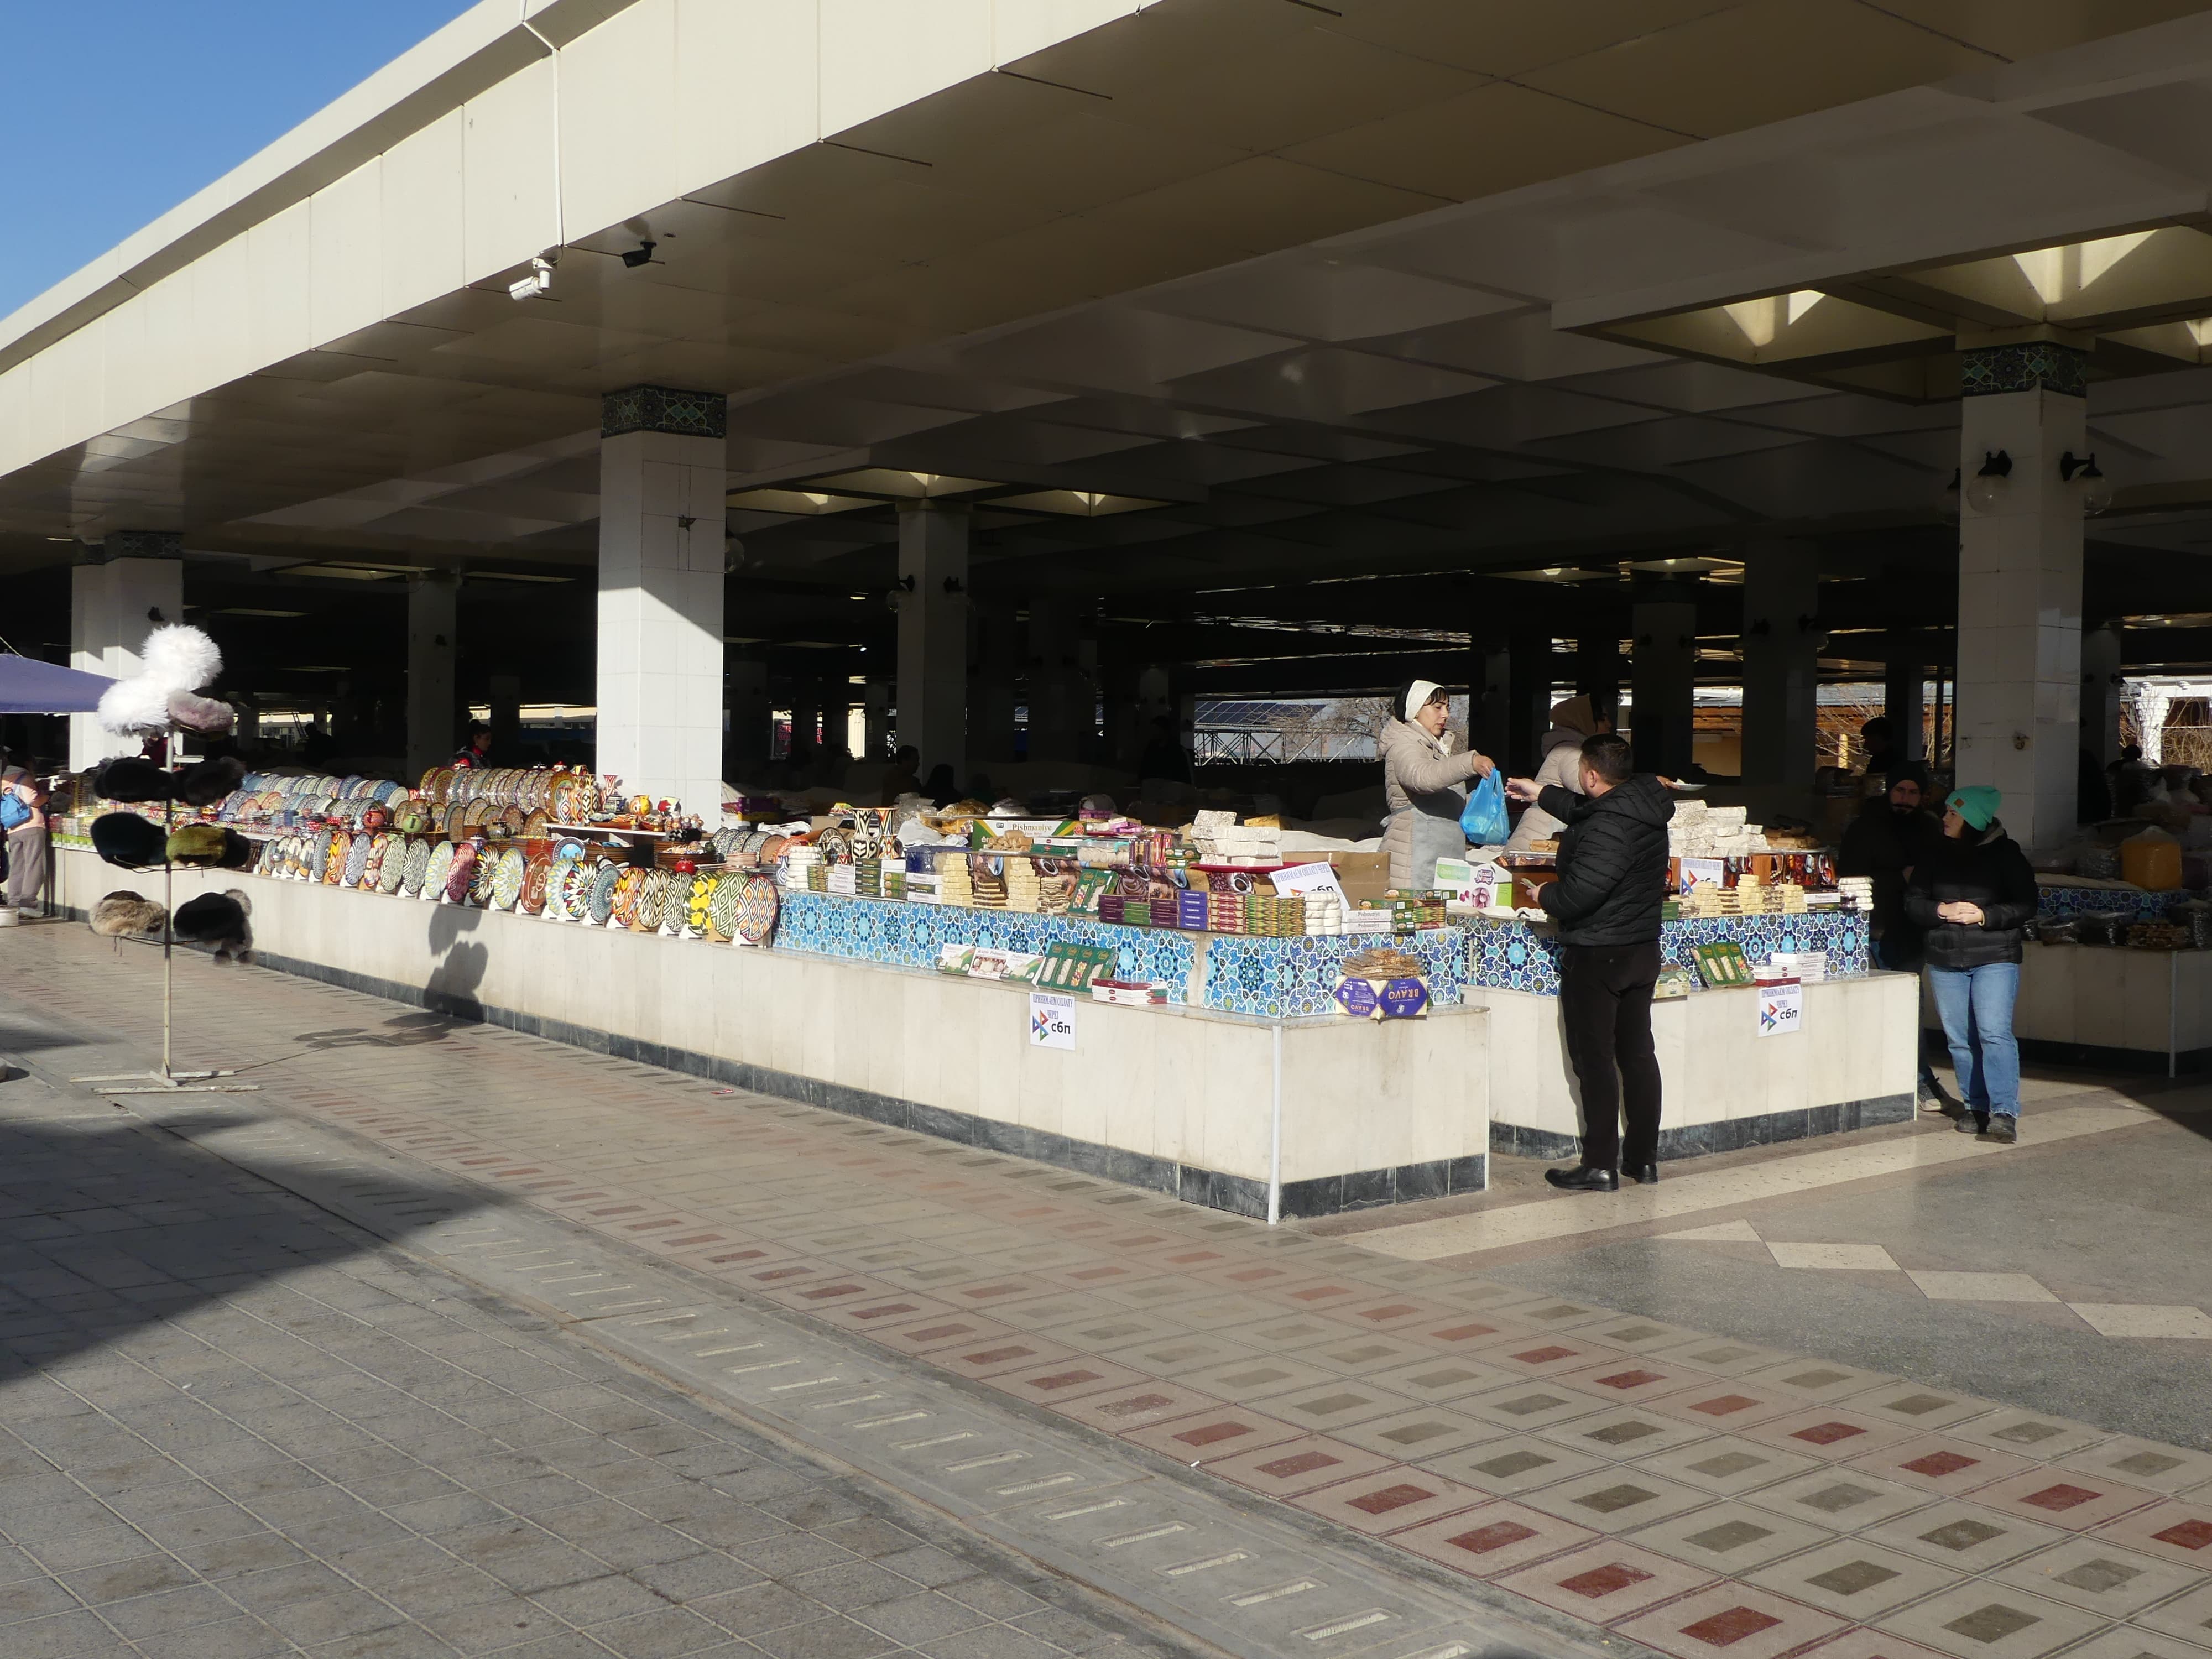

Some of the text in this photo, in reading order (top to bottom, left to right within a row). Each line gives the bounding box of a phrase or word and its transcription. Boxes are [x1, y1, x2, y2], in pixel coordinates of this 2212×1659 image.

[1012, 823, 1052, 832] Pishmaniye
[1389, 988, 1419, 1000] BRAVO
[1780, 1008, 1798, 1020] сбп
[1051, 1021, 1071, 1034] сбп
